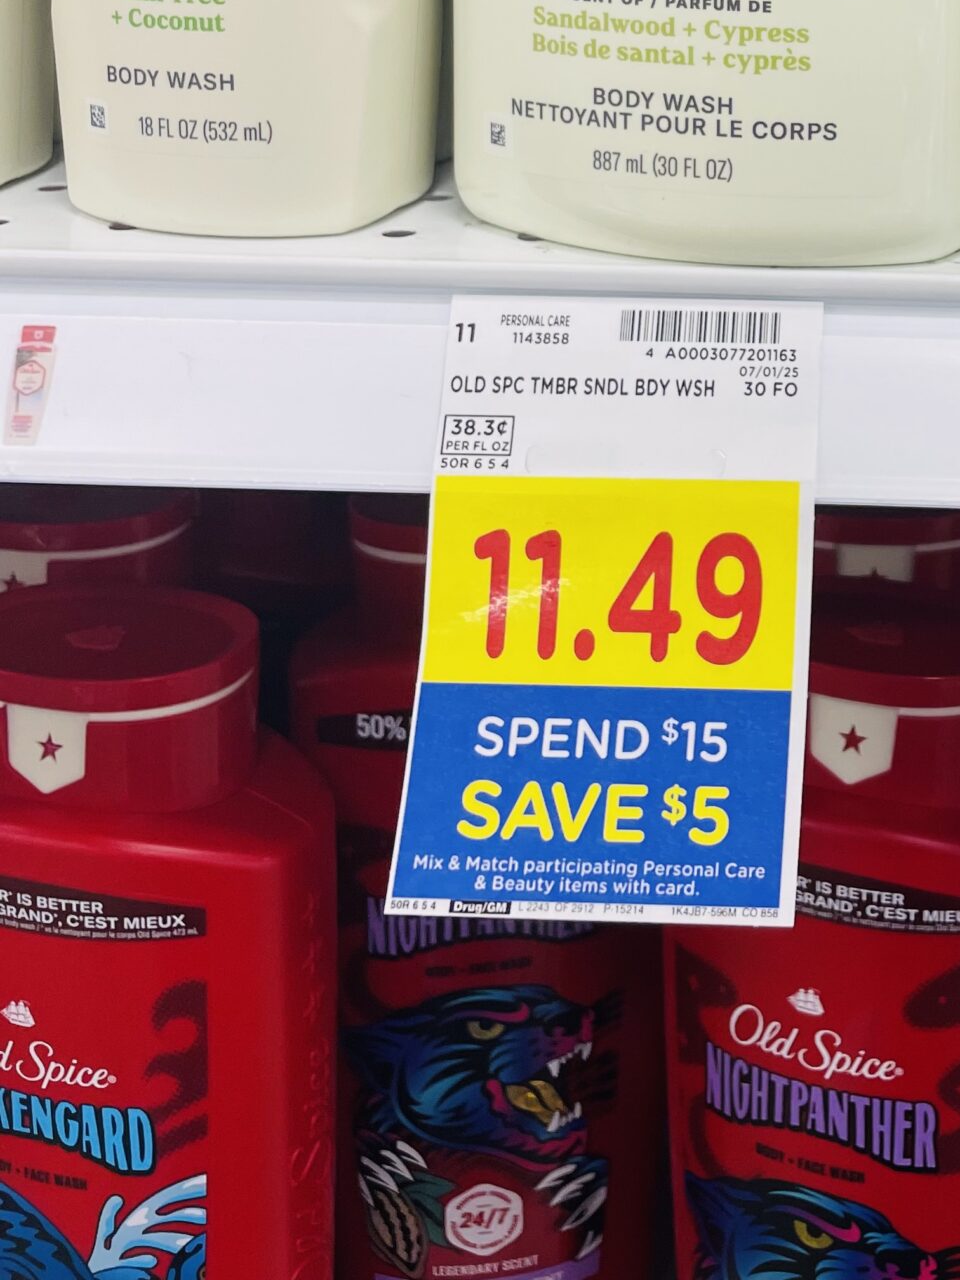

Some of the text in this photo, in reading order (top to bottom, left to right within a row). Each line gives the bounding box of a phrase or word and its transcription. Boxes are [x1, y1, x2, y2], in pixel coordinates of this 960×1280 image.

[128, 8, 226, 33] Coconut
[533, 5, 810, 46] Sandalwood Cypress
[532, 32, 811, 76] Bois santal cyprès
[106, 65, 235, 92] BODY WASH
[592, 87, 734, 115] BODY WASH
[511, 97, 838, 141] NETTOYANT POUR LE CORPS
[592, 150, 621, 172] 887
[500, 314, 570, 327] PERSONAL CARE
[512, 332, 569, 344] 1143858
[665, 347, 797, 362] A0003077201163
[738, 365, 799, 378] 07/01/25
[450, 375, 715, 397] OLD SPC TMBR SNDL BDY WSH
[450, 419, 508, 437] 38.3¢
[473, 528, 763, 665] 11.49
[357, 713, 407, 740] 50%
[474, 715, 728, 763] SPEND $15
[457, 780, 730, 846] SAVE $5
[413, 854, 766, 879] Mix Match participating Personal Care
[492, 877, 650, 895] Beauty items with
[815, 880, 832, 895] IS
[16, 892, 33, 906] IS
[36, 896, 104, 914] BETTER
[453, 901, 508, 914] Drug/GM
[526, 904, 549, 912] 2243
[603, 904, 644, 915] P-15214
[866, 905, 918, 922] C'EST
[66, 914, 119, 930] C'EST
[123, 914, 186, 930] MIEUX
[729, 1003, 798, 1059] Old
[706, 1041, 937, 1169] NIGHTPANTHER
[0, 1088, 154, 1173] ENGARD
[460, 1207, 510, 1229] 24/7
